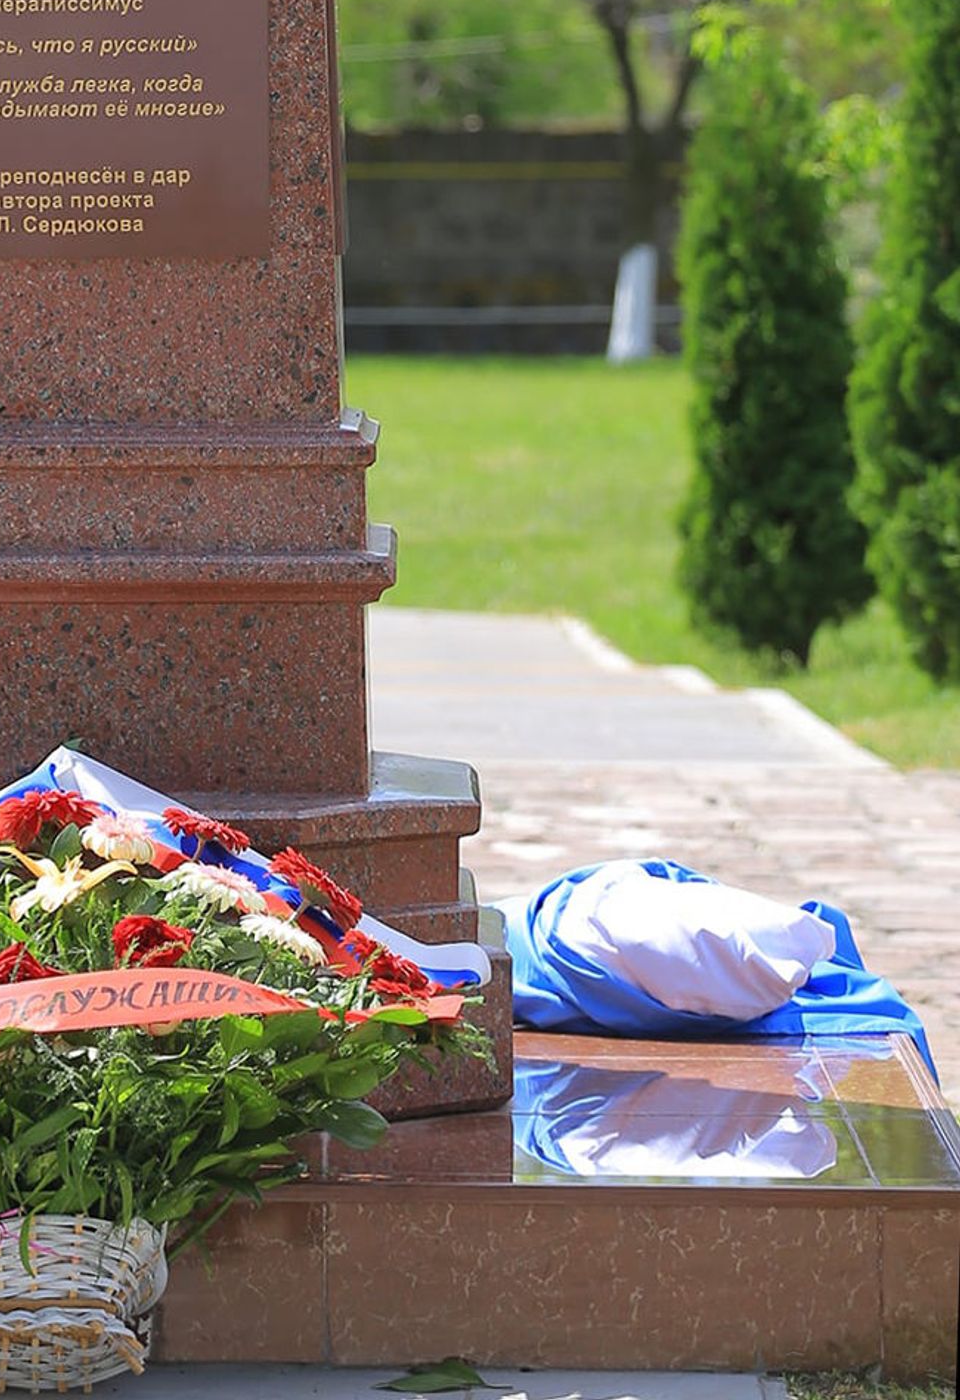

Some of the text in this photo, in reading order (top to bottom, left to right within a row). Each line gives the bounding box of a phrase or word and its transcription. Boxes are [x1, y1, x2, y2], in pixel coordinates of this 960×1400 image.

[32, 40, 74, 54] что
[82, 40, 93, 53] я
[100, 35, 198, 57] русский»
[71, 80, 136, 95] легка,
[144, 74, 203, 92] когда
[105, 100, 128, 117] её
[135, 102, 225, 117] многие»
[134, 171, 144, 184] в
[151, 170, 191, 187] дар
[71, 195, 154, 213] проекта
[24, 216, 144, 237] Сердюкова
